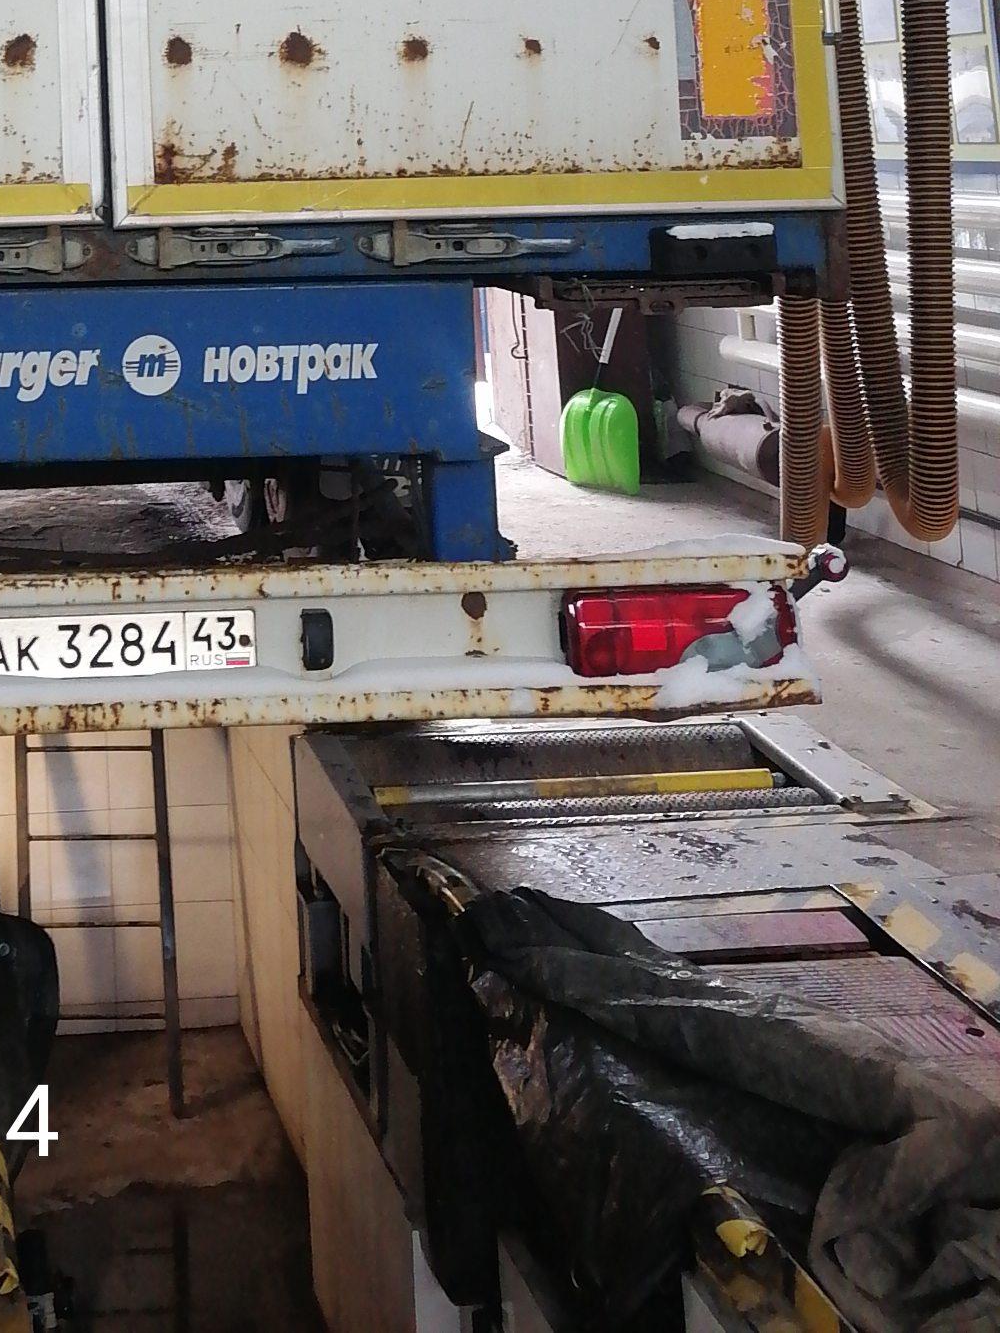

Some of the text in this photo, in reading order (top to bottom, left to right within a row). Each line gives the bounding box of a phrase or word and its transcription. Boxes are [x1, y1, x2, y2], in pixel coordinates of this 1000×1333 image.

[57, 621, 176, 669] 3284
[192, 616, 236, 652] 43
[190, 653, 224, 667] RUS
